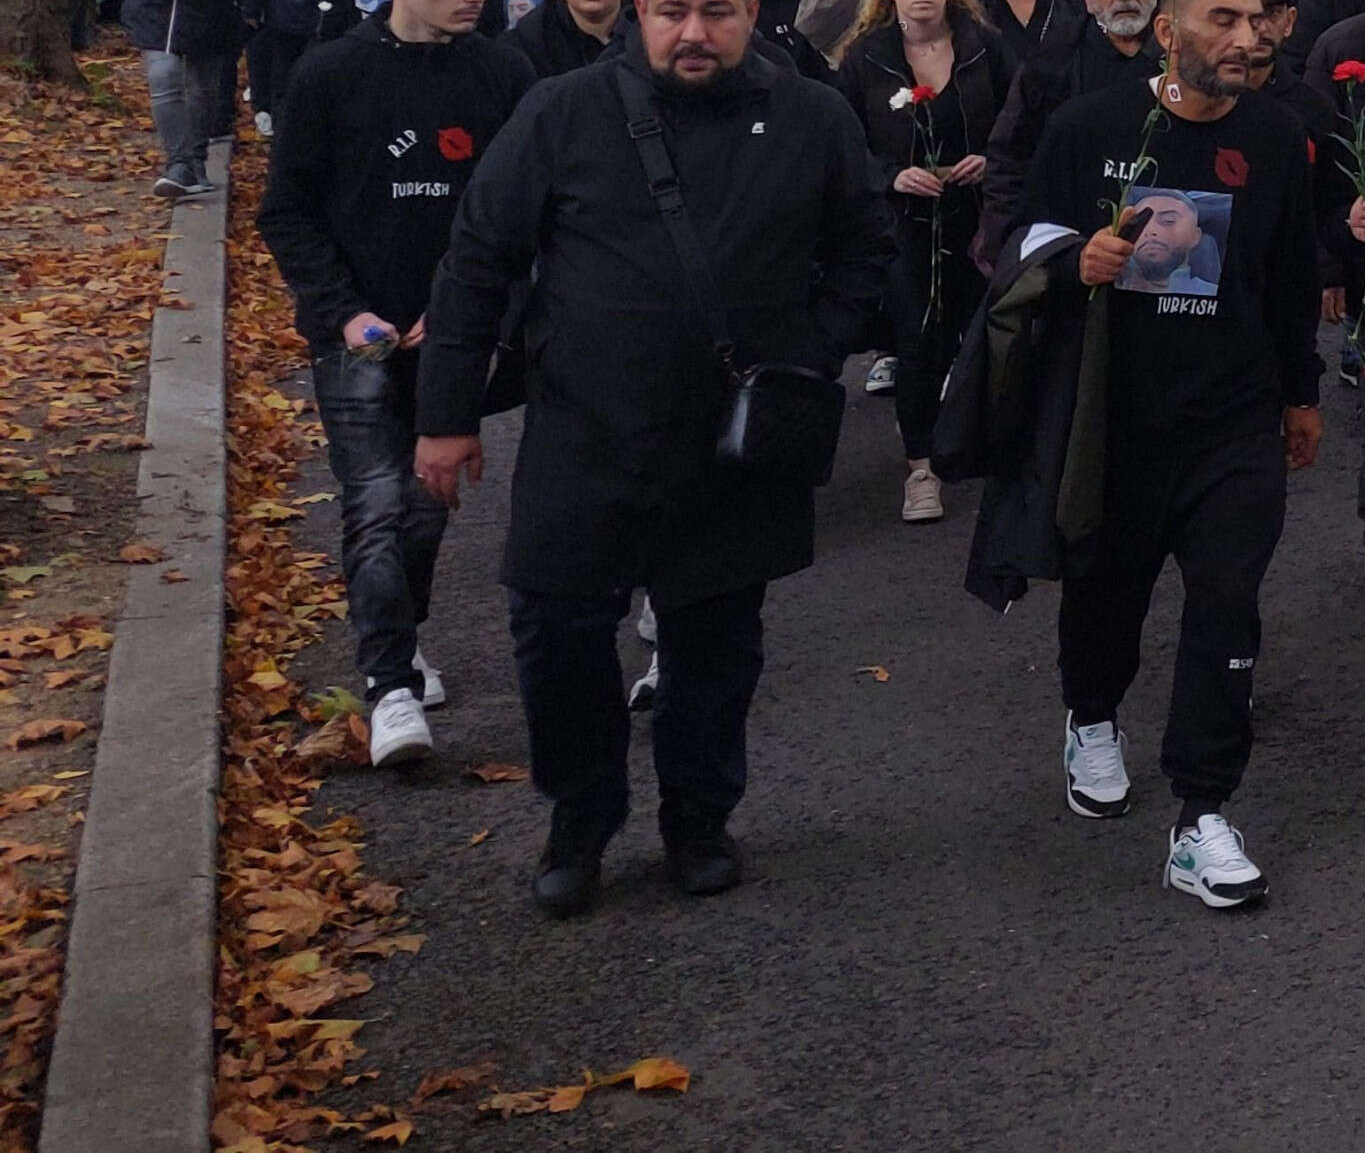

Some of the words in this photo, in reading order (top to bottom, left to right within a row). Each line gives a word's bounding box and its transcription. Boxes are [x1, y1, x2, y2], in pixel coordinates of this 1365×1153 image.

[387, 129, 418, 158] R.I.P
[391, 182, 450, 199] TURKISH
[1157, 295, 1219, 316] TURKISH
